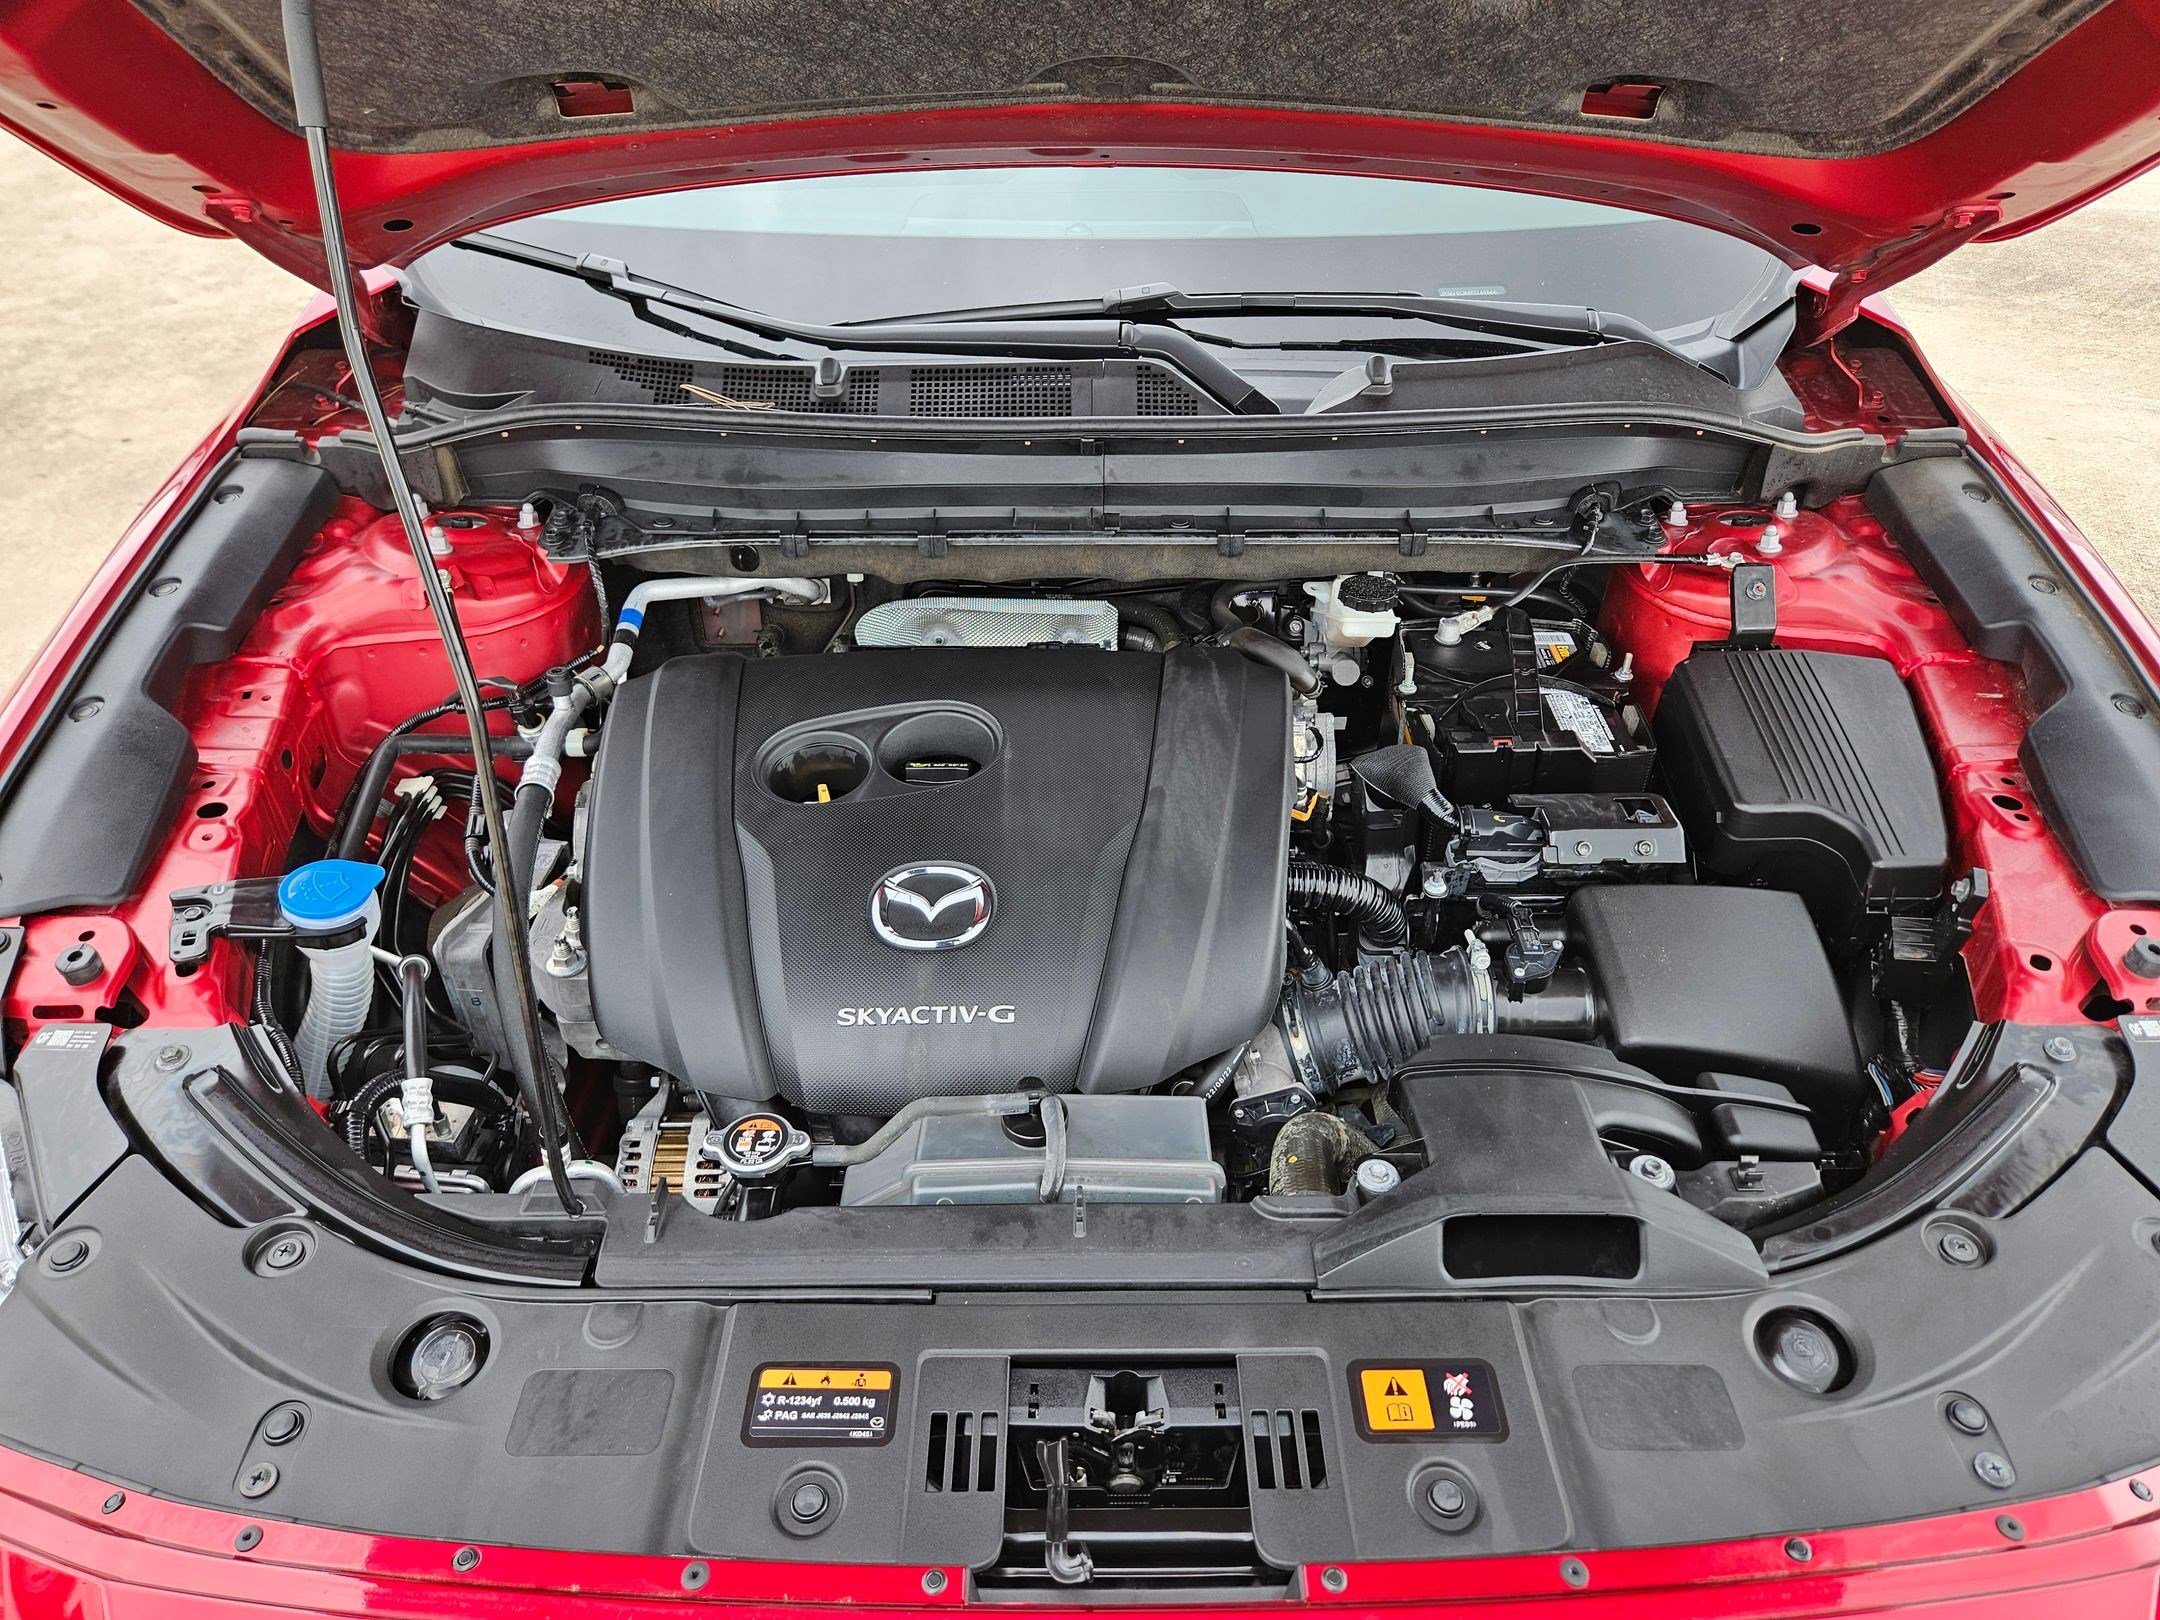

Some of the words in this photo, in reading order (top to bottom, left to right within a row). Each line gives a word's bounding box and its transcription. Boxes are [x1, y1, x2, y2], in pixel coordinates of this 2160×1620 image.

[837, 1005, 1016, 1026] SKYACTIV-G
[777, 1395, 822, 1407] R-1234yf
[833, 1396, 861, 1406] 0.500
[862, 1397, 875, 1408] kg
[774, 1410, 798, 1421] PAG
